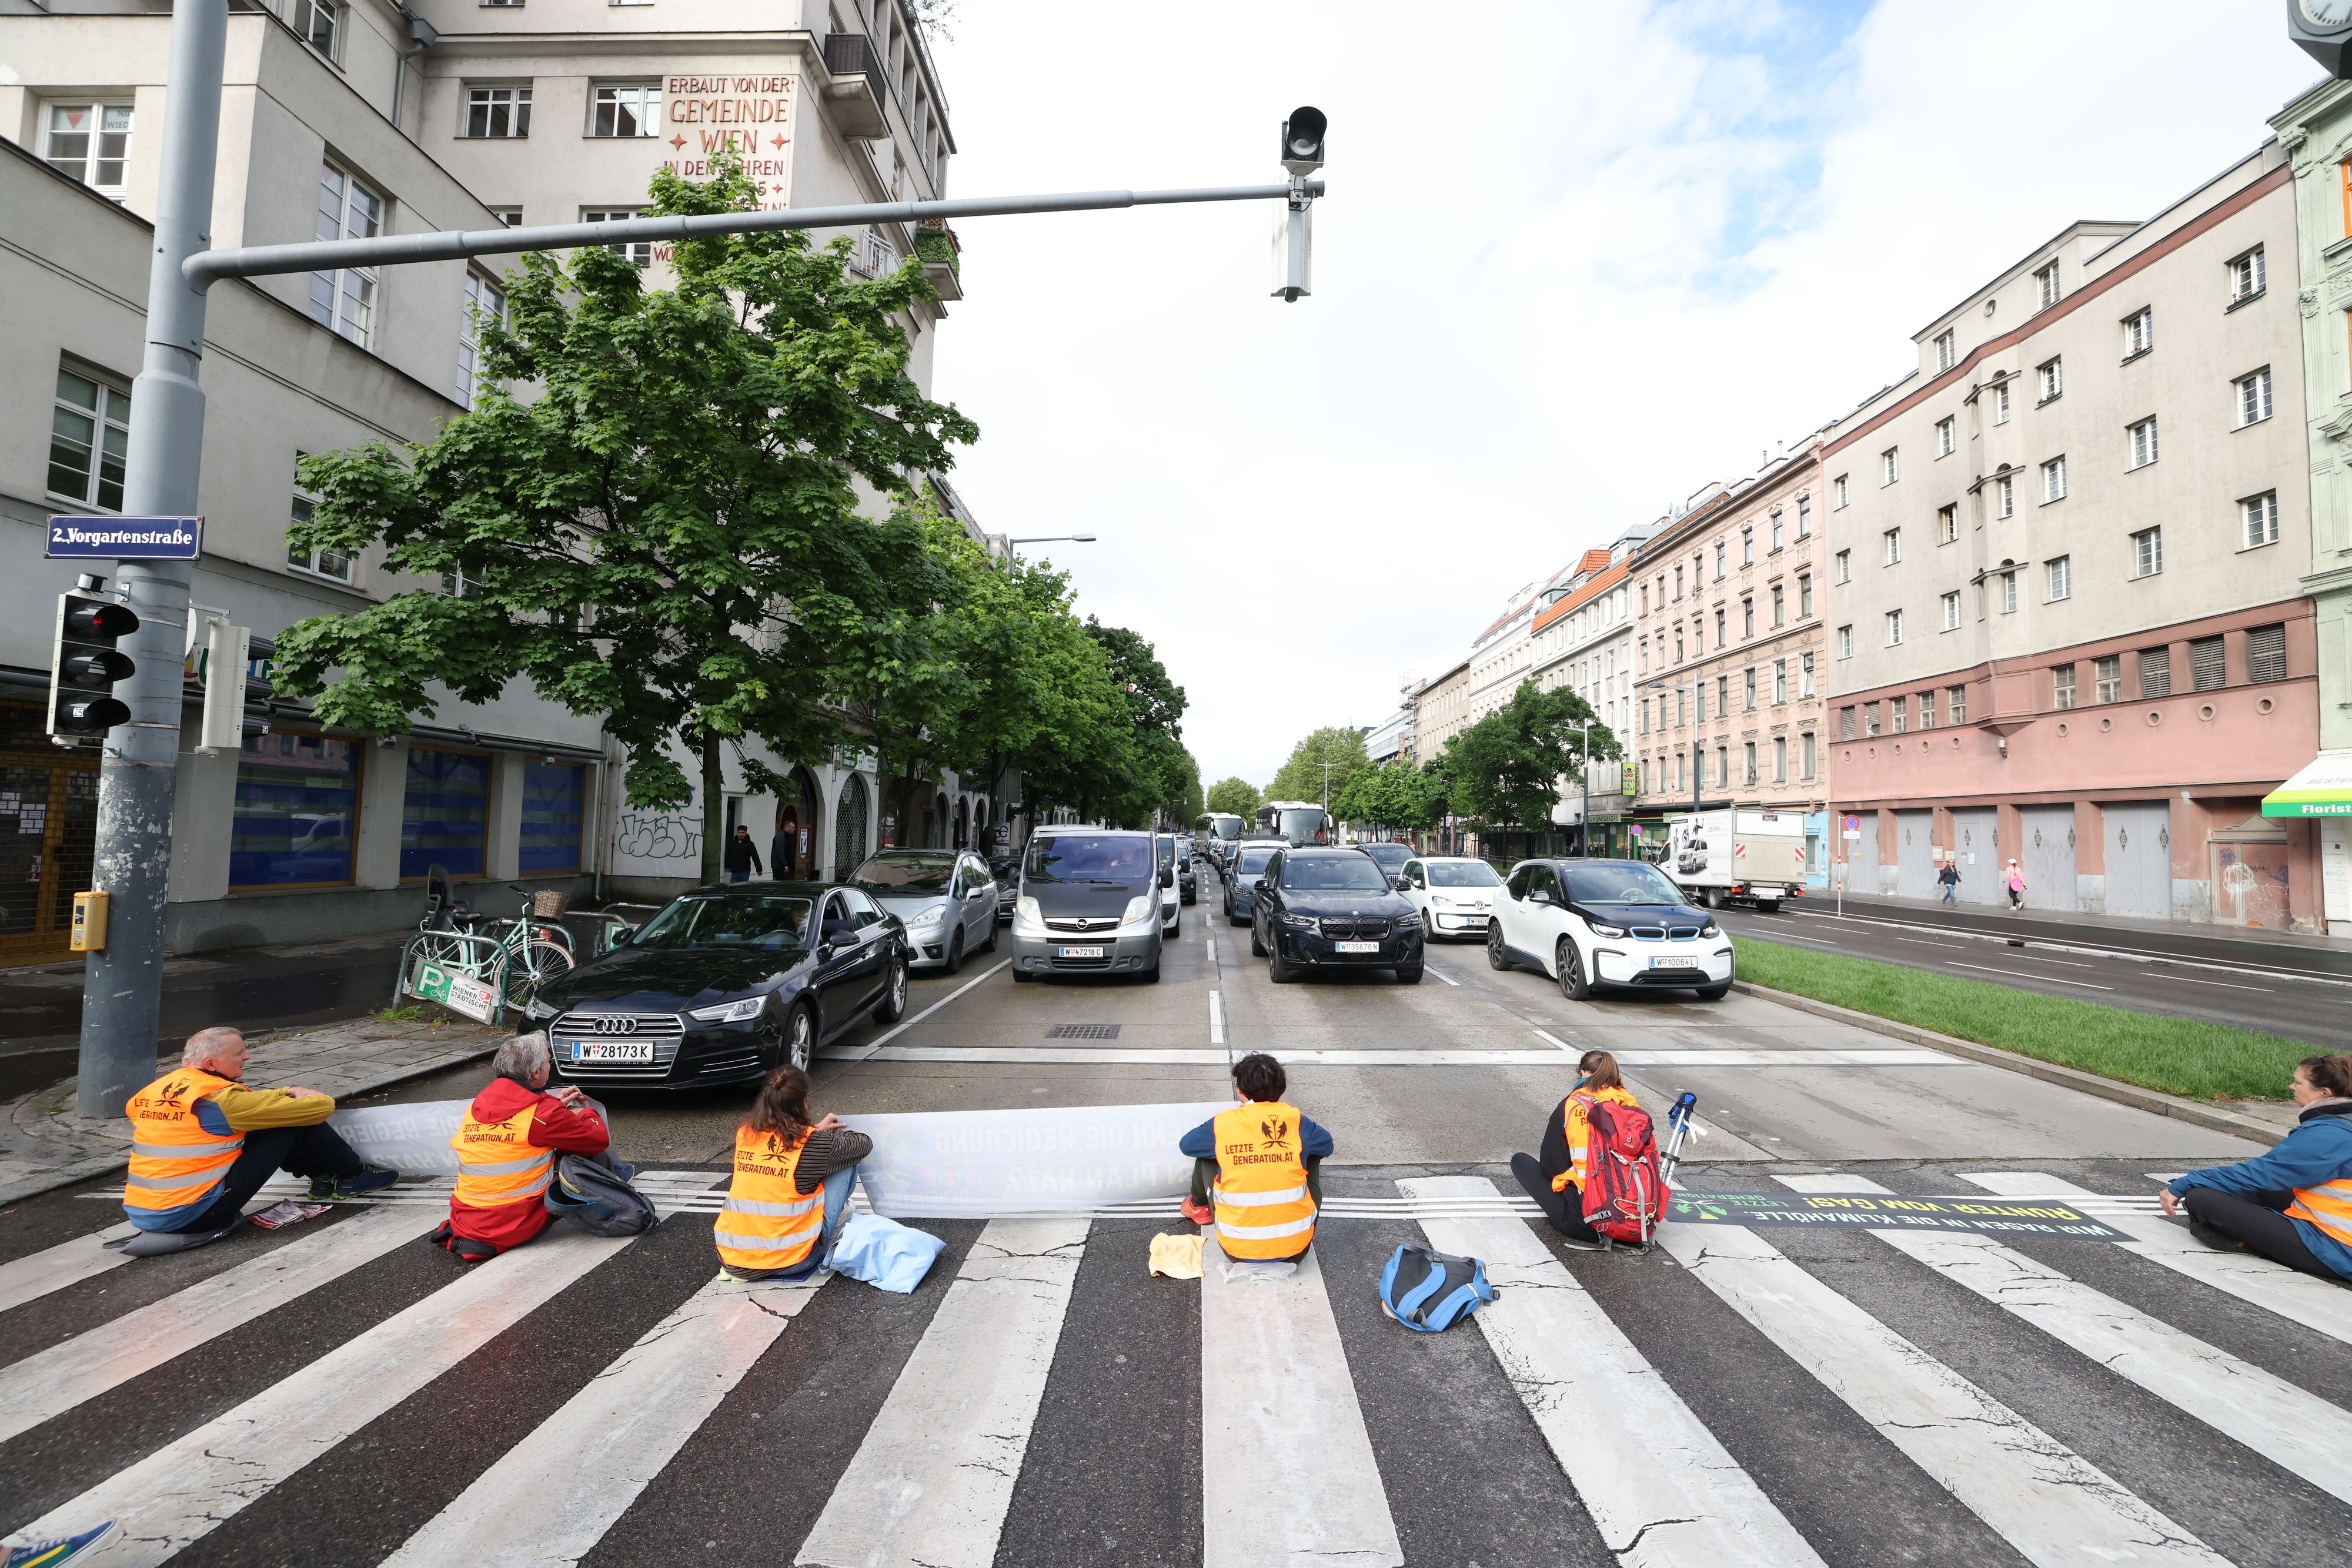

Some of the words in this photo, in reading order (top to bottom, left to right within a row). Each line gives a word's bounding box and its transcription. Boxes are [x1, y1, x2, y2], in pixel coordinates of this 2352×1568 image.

[669, 78, 727, 93] ERBAUT
[730, 77, 757, 92] VON
[761, 77, 790, 92] DER
[669, 99, 790, 123] GEMEINDE
[699, 129, 757, 153] WIEN
[719, 160, 783, 175] HREN
[74, 708, 83, 717] 25
[2301, 804, 2352, 814] Florist
[419, 965, 444, 992] P
[452, 984, 477, 999] WIENER
[463, 1124, 482, 1133] LETZTE
[463, 1133, 516, 1143] GENERATION.AT
[1225, 1144, 1254, 1154] LETZTE
[737, 1150, 754, 1161] LETZTE
[1233, 1152, 1293, 1165] GENERATION.AT
[737, 1162, 789, 1178] GENERATION.AT
[1802, 1198, 1878, 1209] GAS!
[1878, 1199, 1951, 1213] VOM
[1743, 1210, 1897, 1224] KLIMAHÖLLE.
[1950, 1203, 2082, 1220] RUNTER
[1896, 1215, 1941, 1226] DIE
[1941, 1218, 1972, 1228] IN
[1971, 1221, 2058, 1233] RASEN
[2055, 1225, 2115, 1236] WIR
